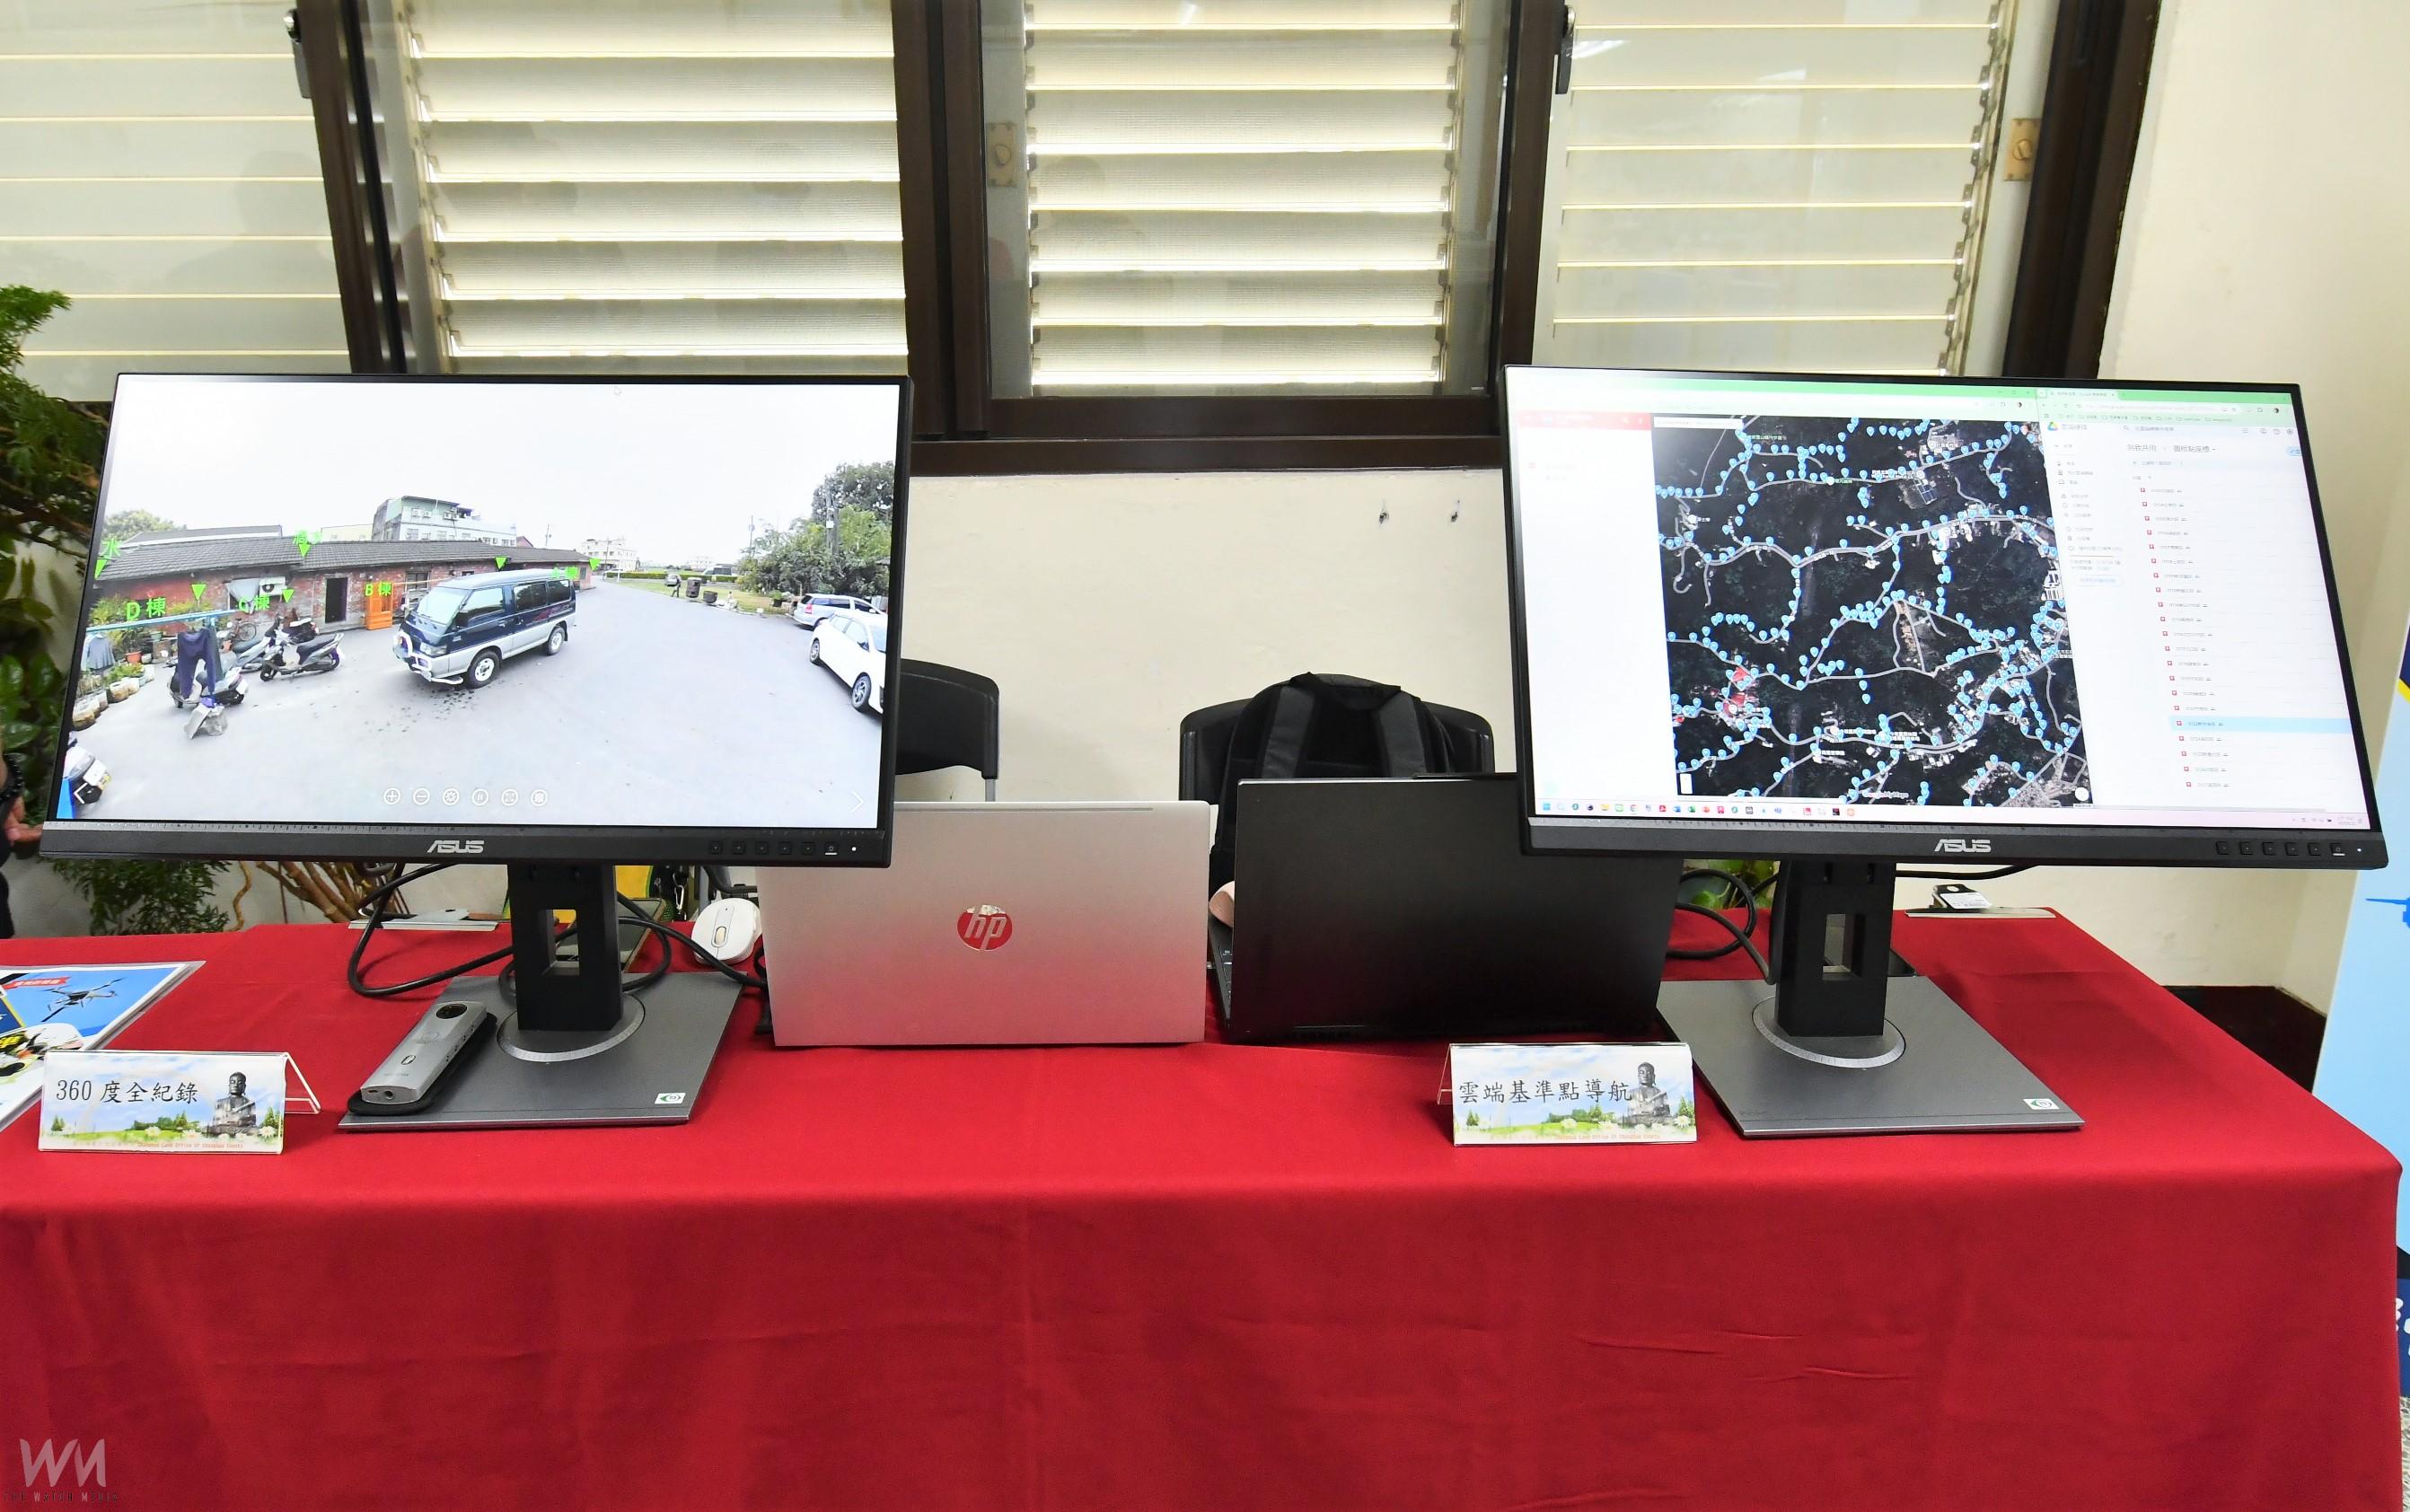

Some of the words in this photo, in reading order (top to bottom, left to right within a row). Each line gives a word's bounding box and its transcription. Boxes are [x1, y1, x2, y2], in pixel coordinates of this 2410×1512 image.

[427, 840, 485, 854] ASUS
[1934, 840, 1992, 853] ASUS
[963, 904, 1007, 950] hp
[1459, 1079, 1632, 1103] 雲端基準點導航
